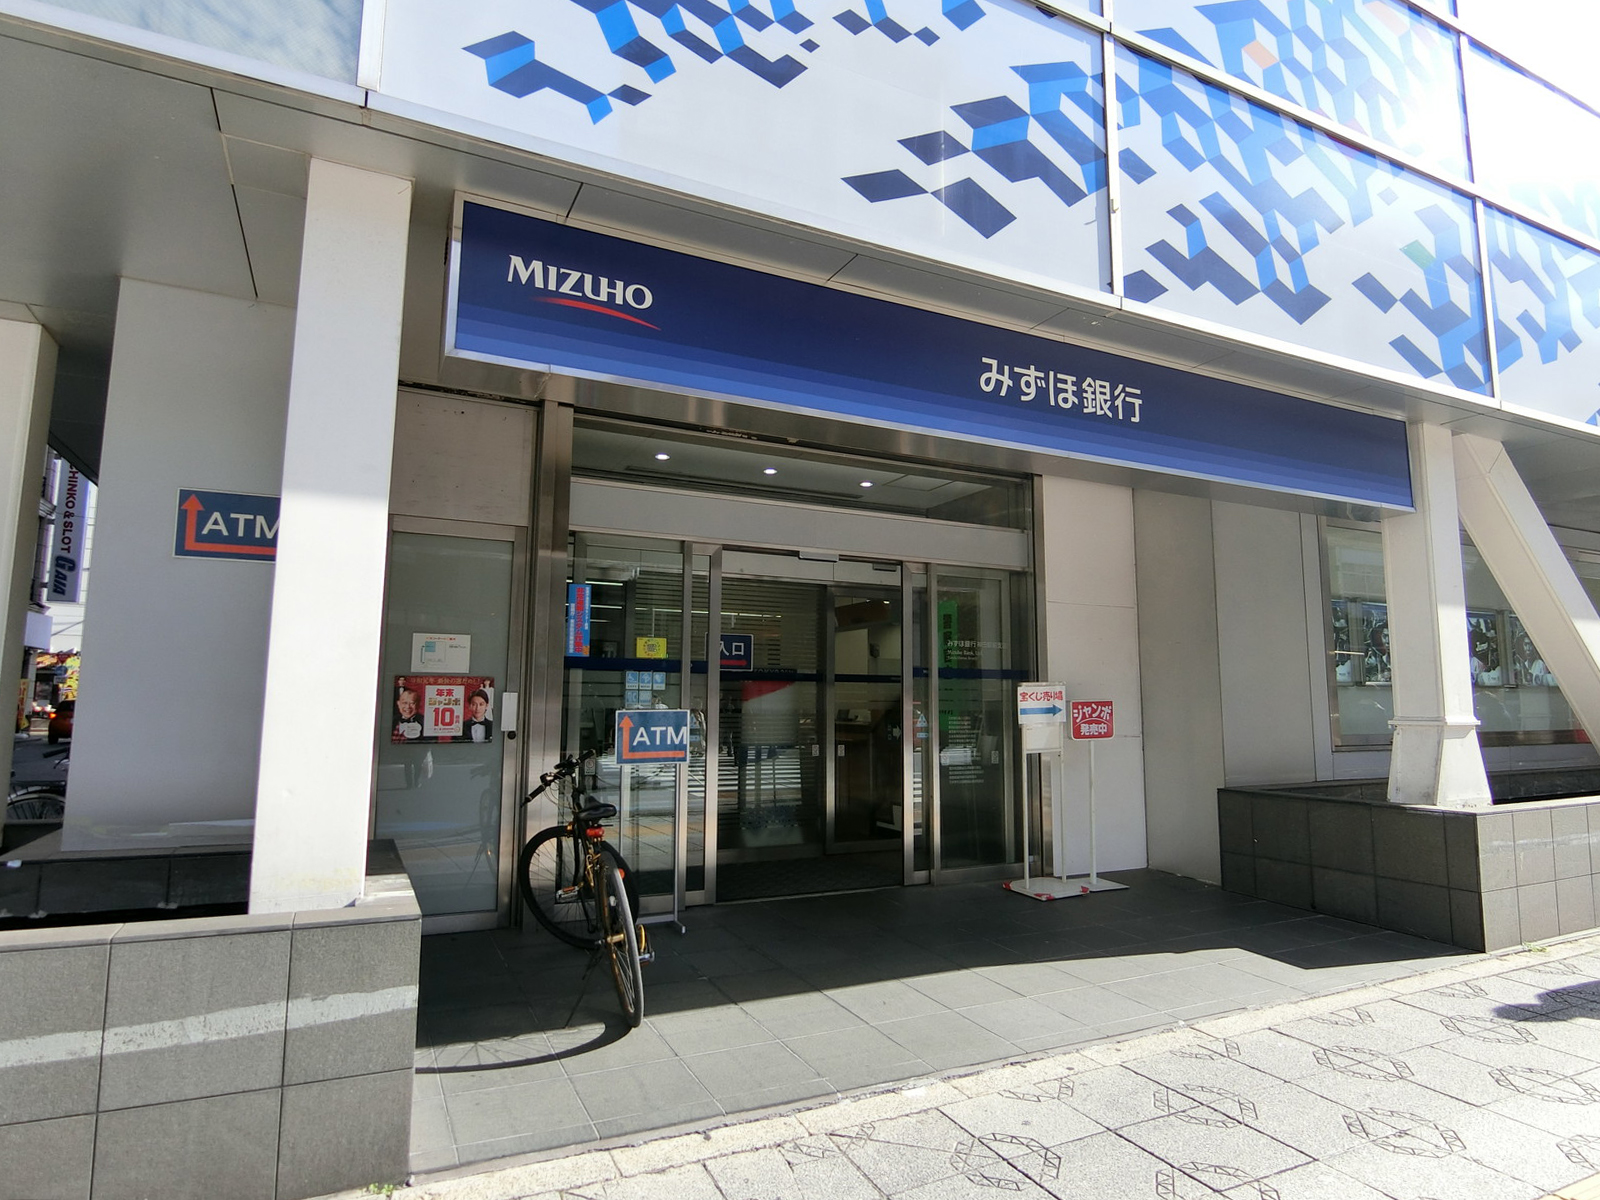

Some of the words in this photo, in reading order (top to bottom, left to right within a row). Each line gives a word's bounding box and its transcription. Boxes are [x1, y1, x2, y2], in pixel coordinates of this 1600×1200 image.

[507, 254, 654, 310] MIZUHO
[979, 356, 1143, 423] みずほ銀行
[201, 511, 280, 539] ATM
[60, 520, 74, 553] SLOT
[428, 697, 461, 707] ジャンボ
[435, 688, 455, 697] 年末
[1019, 690, 1064, 703] 宝くじ売り場
[433, 707, 455, 727] 10
[1073, 703, 1112, 723] ジャンボ
[632, 726, 687, 746] ATM
[1080, 723, 1108, 736] 発売中
